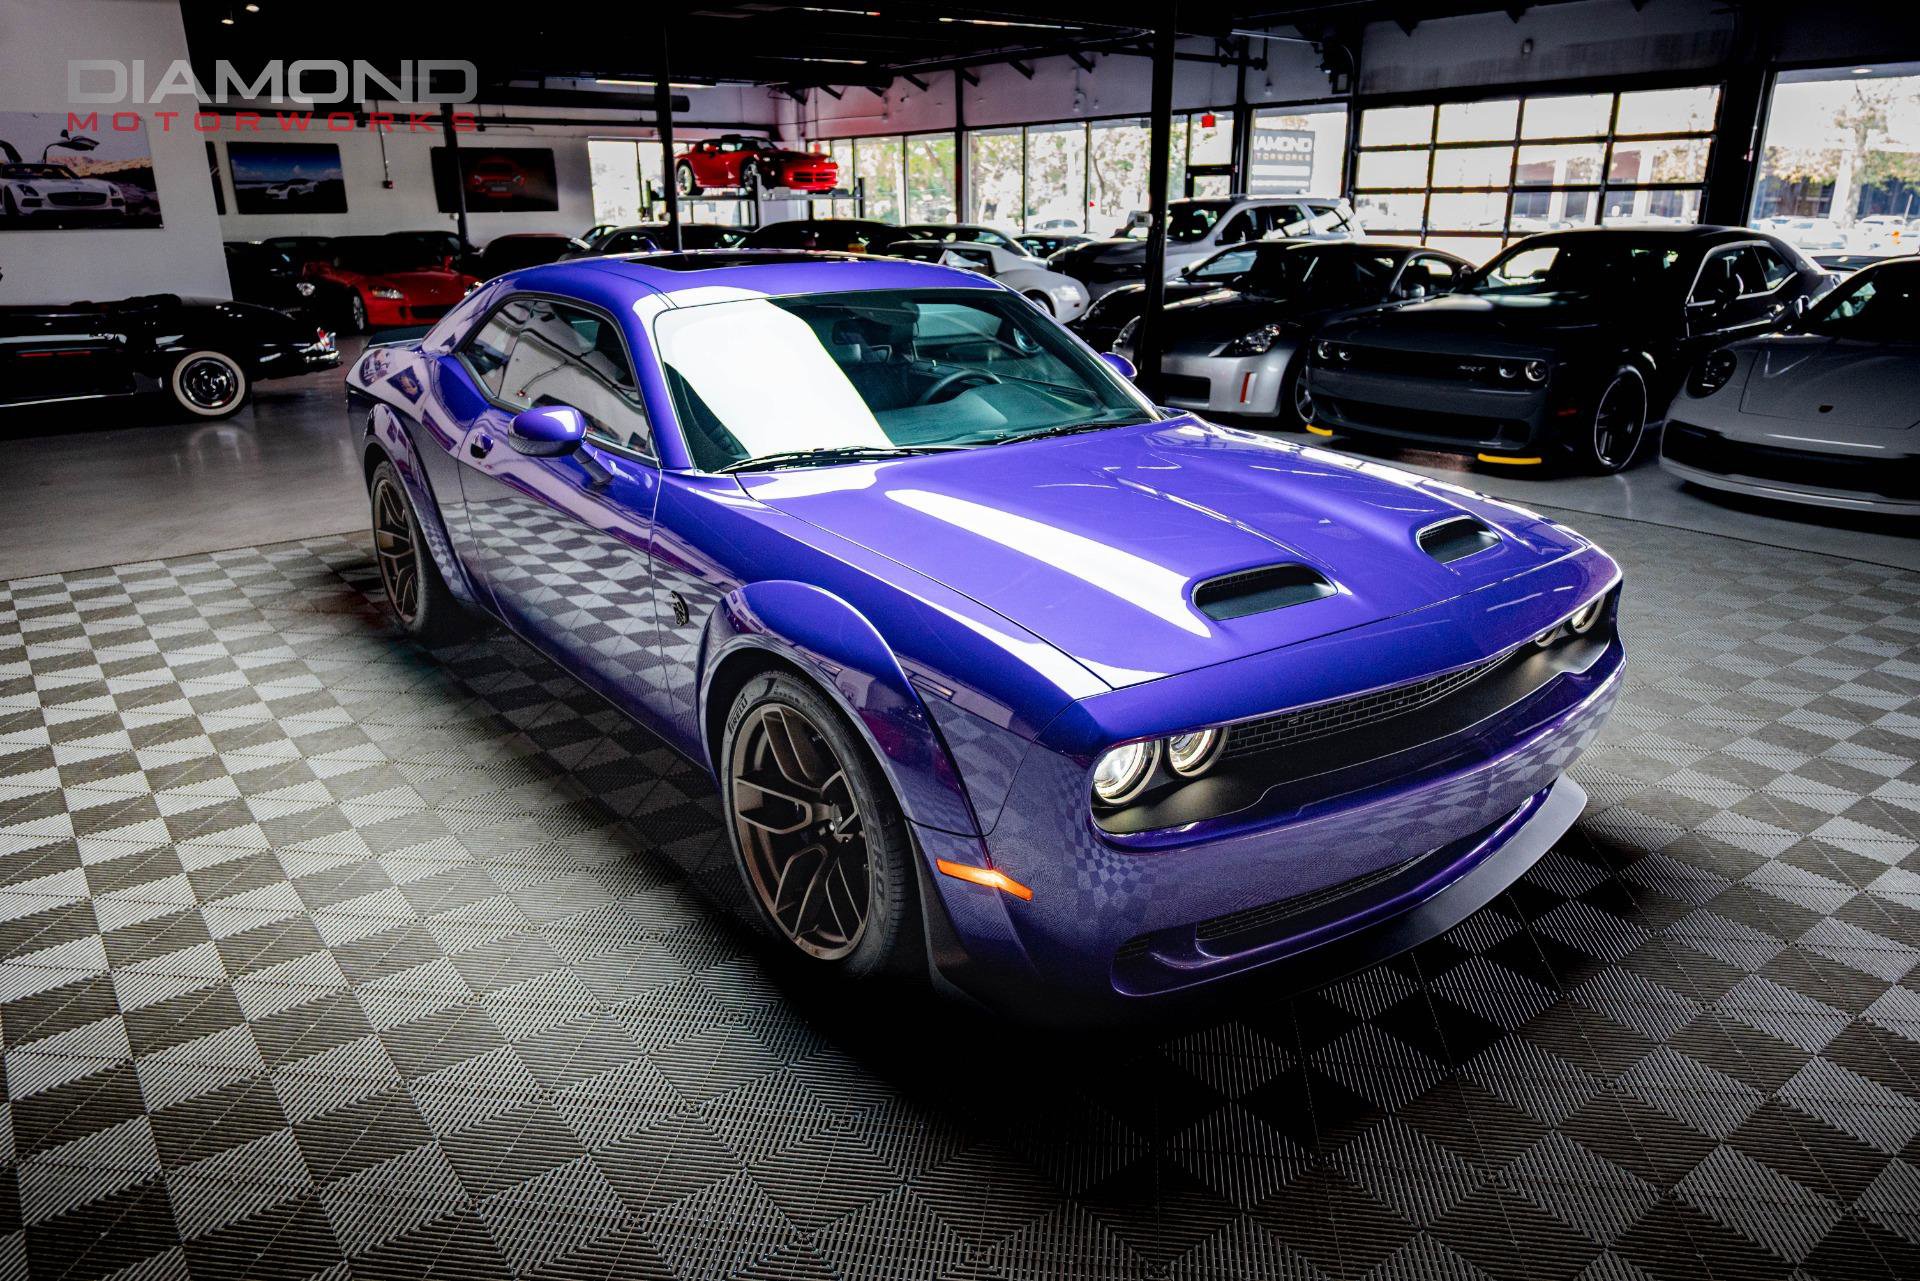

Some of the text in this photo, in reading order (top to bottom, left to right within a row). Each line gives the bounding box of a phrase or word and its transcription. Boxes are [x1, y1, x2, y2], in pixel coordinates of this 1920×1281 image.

[1253, 135, 1313, 153] IAMOND
[1255, 152, 1311, 161] TORWORKS
[726, 692, 748, 735] PIRELLI
